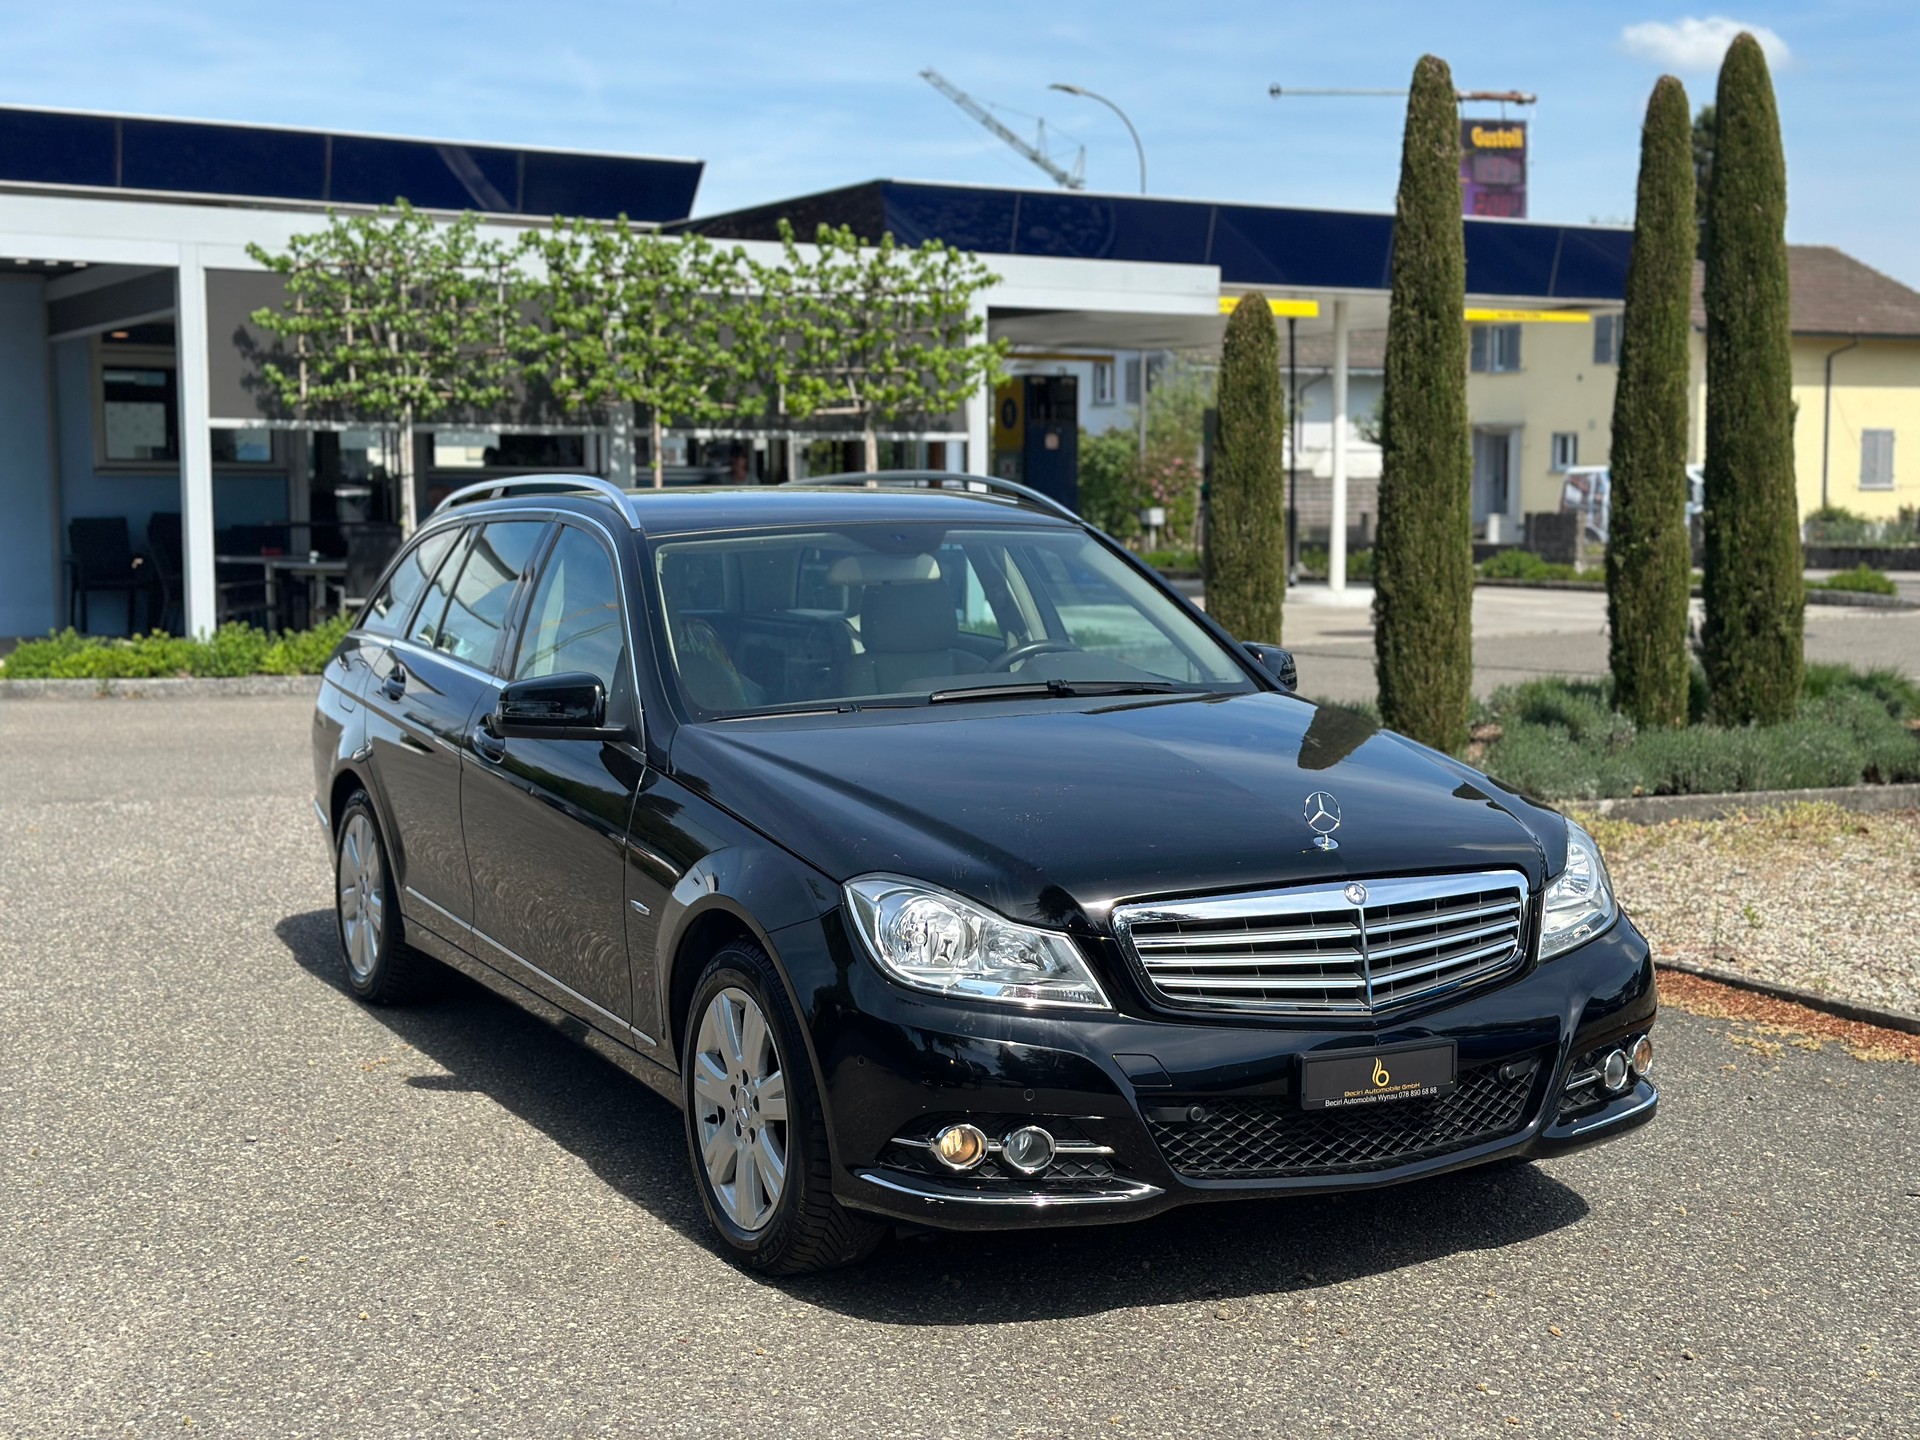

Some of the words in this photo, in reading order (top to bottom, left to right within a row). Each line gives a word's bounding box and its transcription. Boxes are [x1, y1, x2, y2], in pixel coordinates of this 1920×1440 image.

[1325, 1098, 1343, 1107] Beciri
[1343, 1096, 1377, 1105] Automobile
[1378, 1093, 1398, 1102] Wynau
[1398, 1090, 1410, 1099] 078
[1410, 1088, 1422, 1097] 890
[1421, 1087, 1430, 1095] 68
[1429, 1086, 1438, 1094] 88
[1344, 1089, 1363, 1097] Beciri
[1365, 1085, 1401, 1095] Automobile
[1402, 1082, 1421, 1090] GmbH
